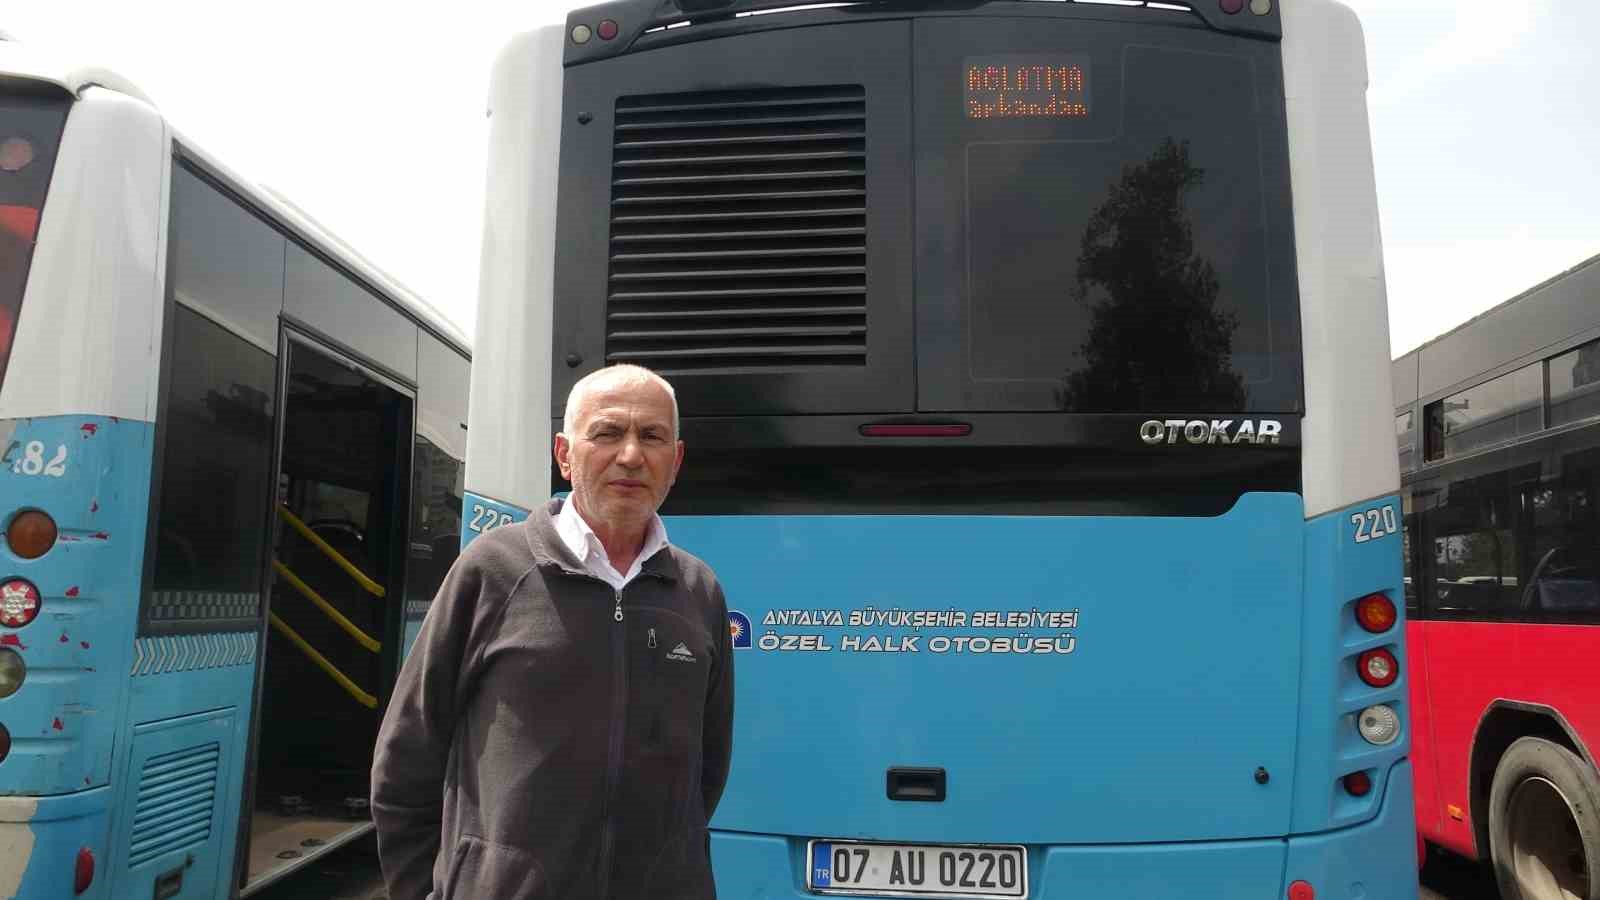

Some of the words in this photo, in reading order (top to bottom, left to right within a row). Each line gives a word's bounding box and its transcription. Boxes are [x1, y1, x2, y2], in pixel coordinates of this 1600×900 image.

[1140, 419, 1282, 444] OTOKAR
[1350, 504, 1397, 543] 220
[762, 609, 844, 626] ANTALYA
[849, 606, 967, 632] BÜYÜKŞEHİR
[971, 607, 1080, 629] BELEDİYESİ
[758, 630, 833, 652] ÖZEL
[840, 635, 921, 653] HALK
[928, 632, 1077, 654] OTOBÜSÜ
[815, 868, 829, 880] TR
[833, 848, 870, 883] 07
[889, 850, 925, 886] AU
[939, 851, 1017, 889] 0220
